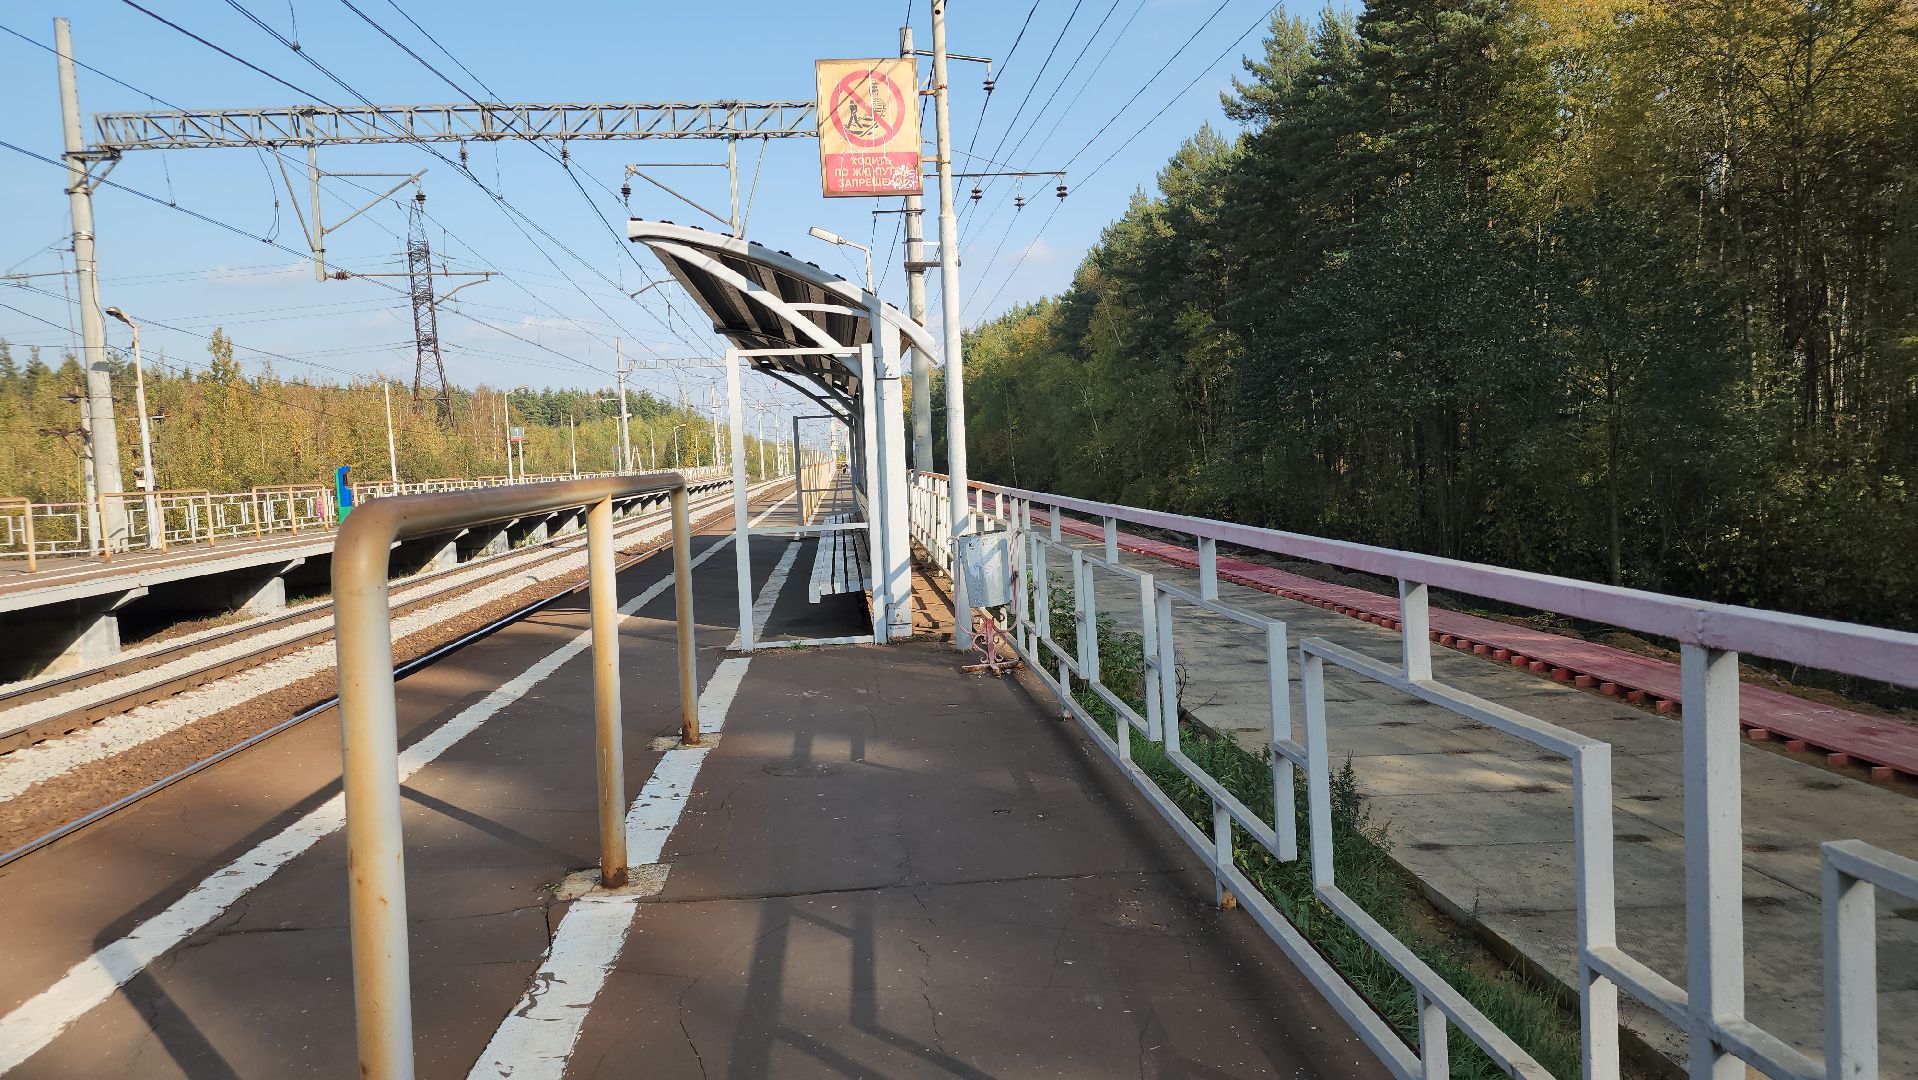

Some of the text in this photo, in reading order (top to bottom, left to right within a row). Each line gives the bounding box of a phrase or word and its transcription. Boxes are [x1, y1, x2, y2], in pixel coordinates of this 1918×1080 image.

[851, 156, 891, 165] ХОДИТЬ
[834, 167, 849, 177] ПО
[875, 166, 909, 177] ПУТ
